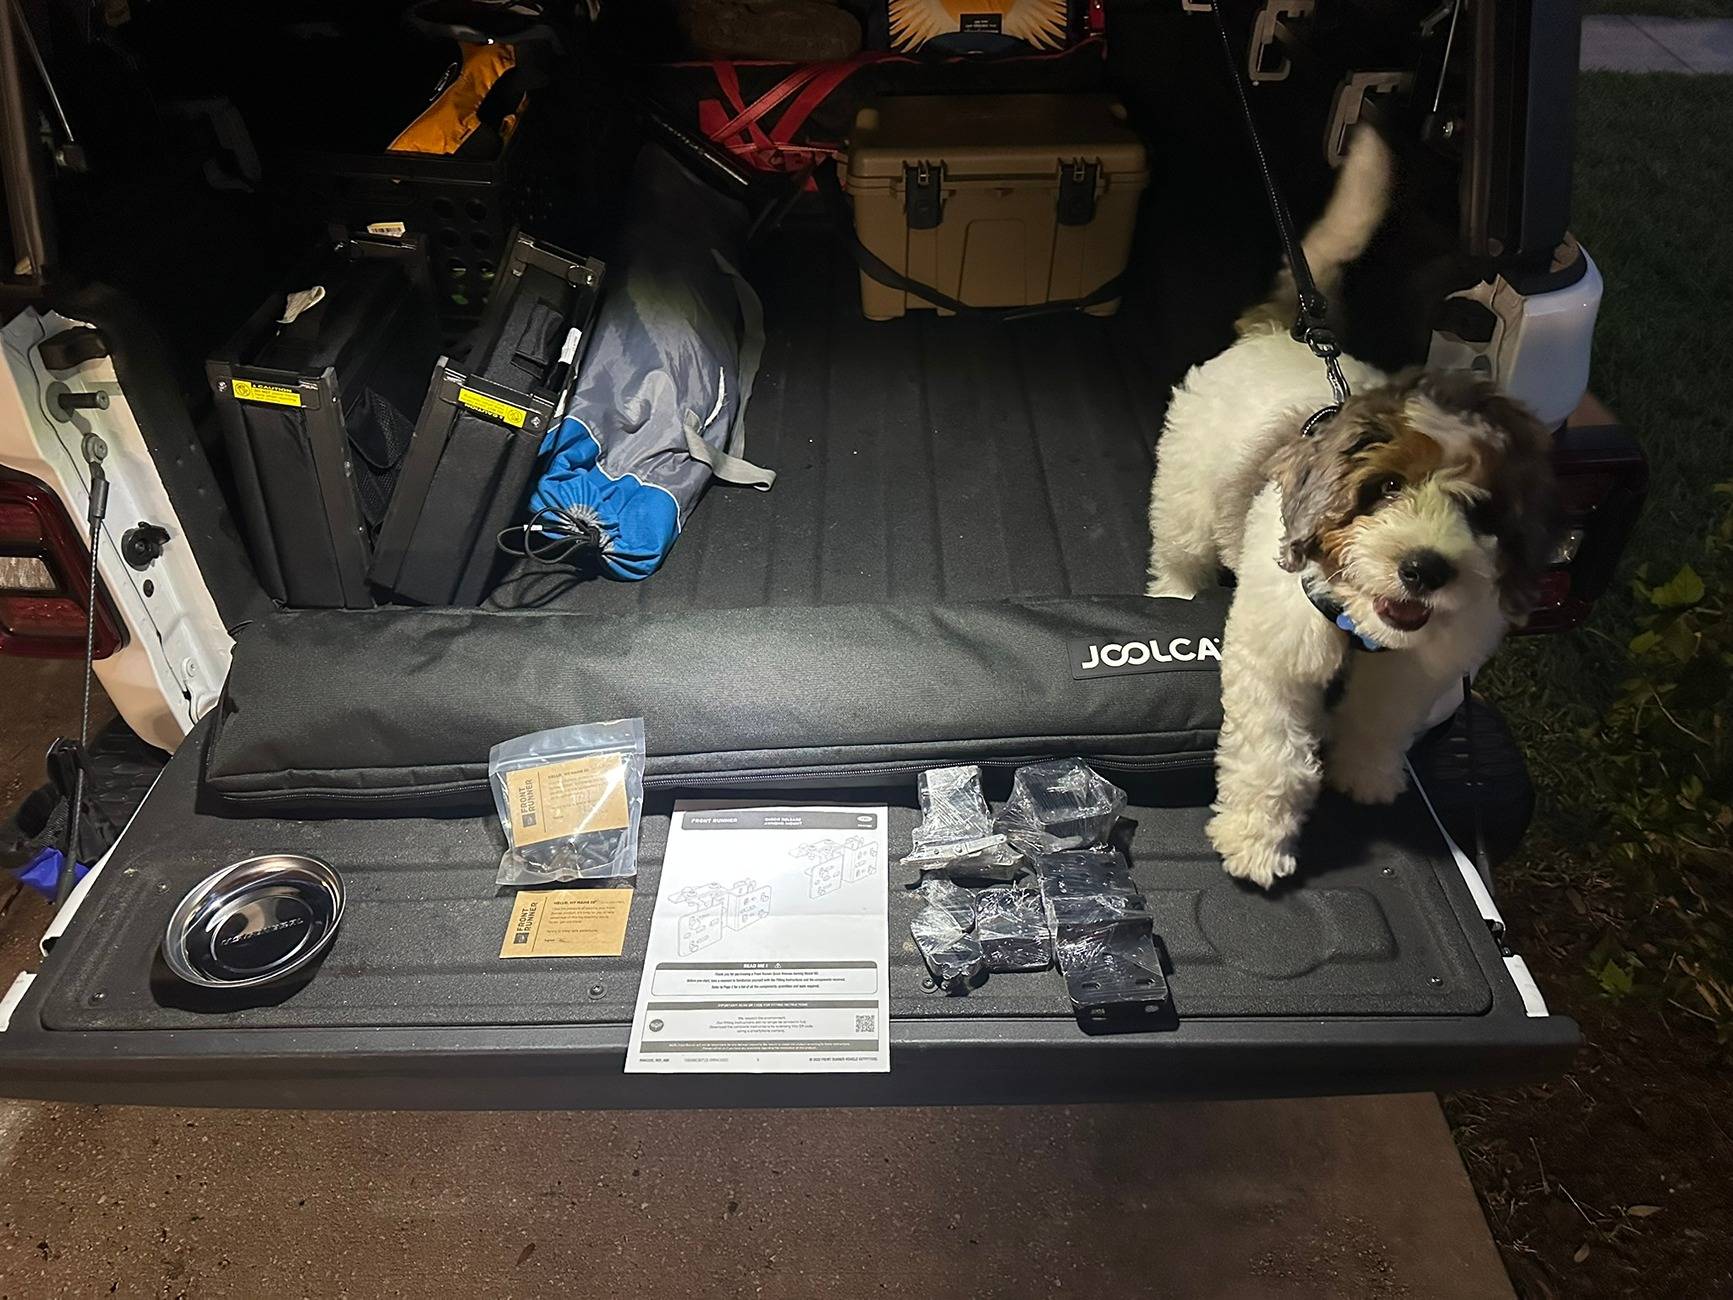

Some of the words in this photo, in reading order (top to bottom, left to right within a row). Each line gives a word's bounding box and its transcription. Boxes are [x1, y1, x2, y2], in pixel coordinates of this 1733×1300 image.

[1081, 637, 1222, 669] JOOLCA
[518, 787, 529, 813] FRONT
[525, 779, 536, 812] RUNNER
[517, 908, 529, 931] FRONT
[524, 902, 538, 931] RUNNER
